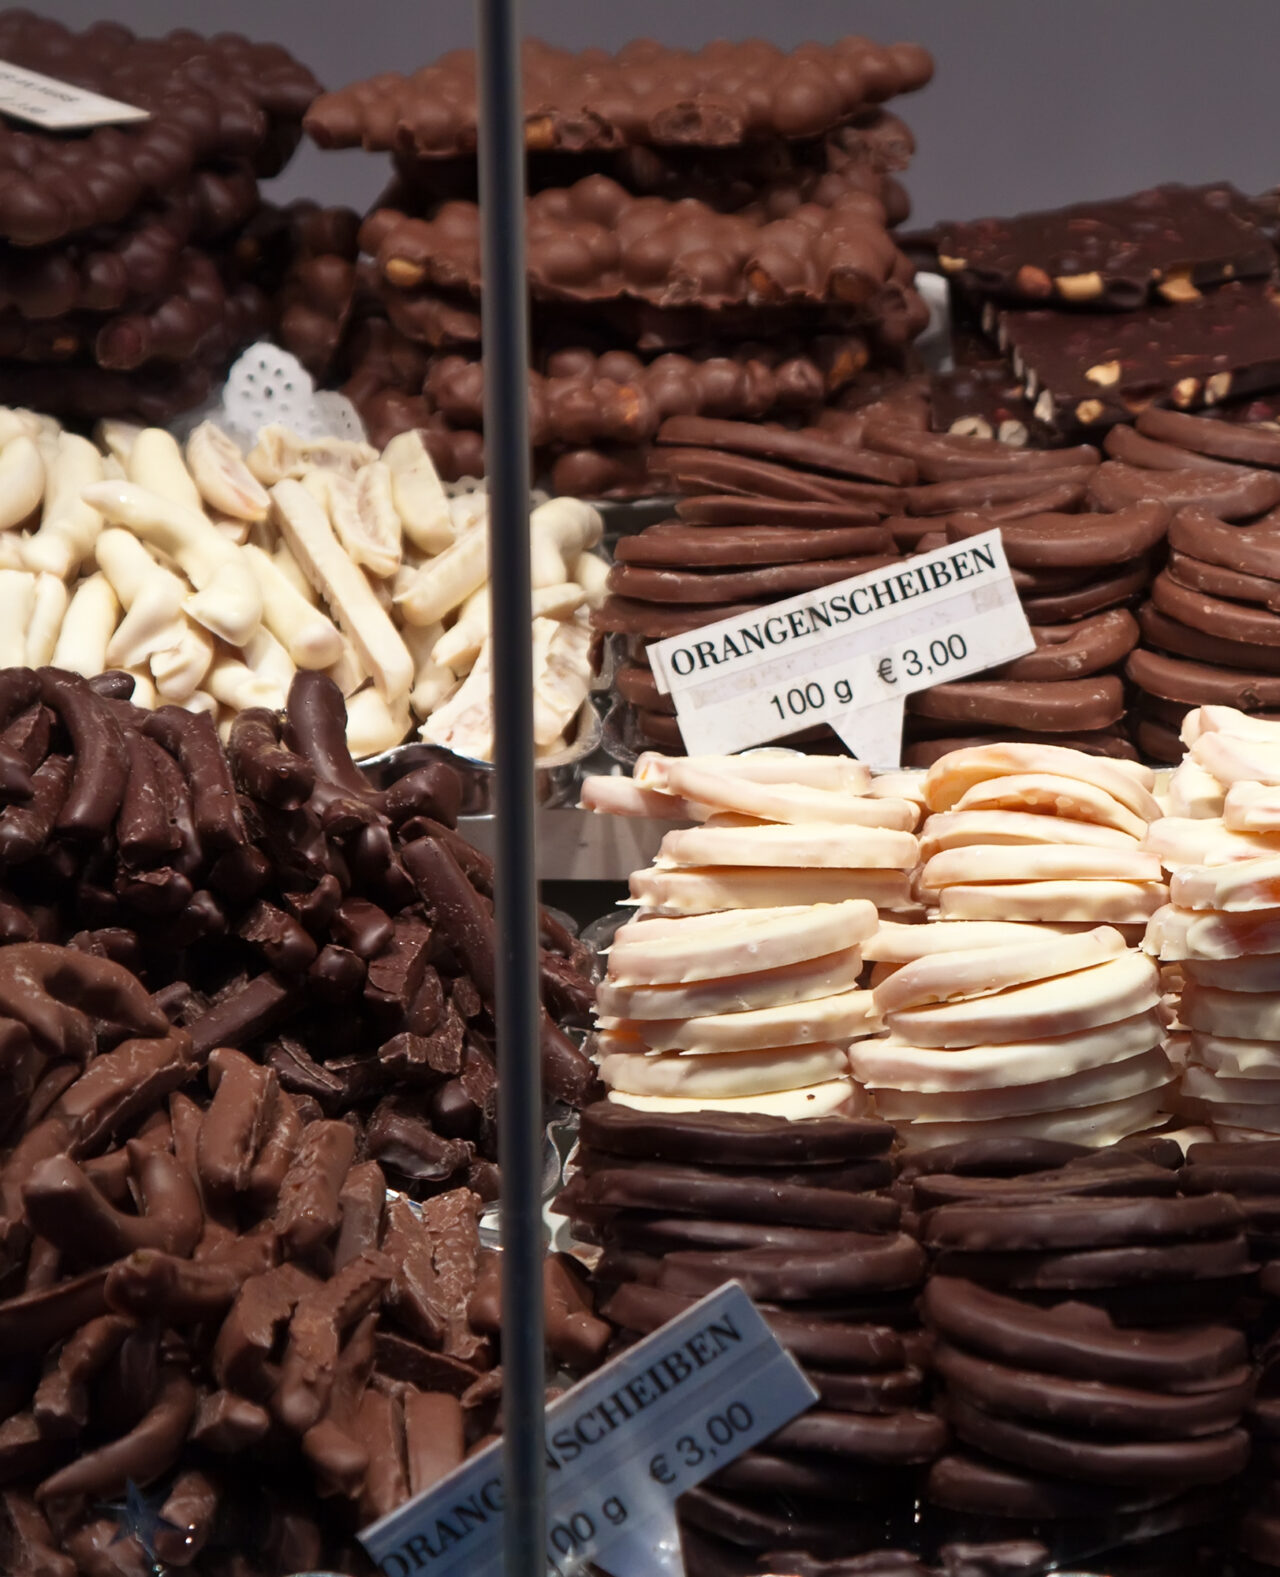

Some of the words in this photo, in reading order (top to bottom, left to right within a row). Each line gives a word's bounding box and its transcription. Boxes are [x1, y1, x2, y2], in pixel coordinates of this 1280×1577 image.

[670, 543, 997, 676] ORANGENSCHEIBEN
[770, 682, 826, 720] 100
[834, 679, 854, 704] g
[876, 657, 898, 684] €
[902, 633, 968, 675] 3,00
[602, 1495, 627, 1526] g
[649, 1453, 677, 1486] €
[676, 1401, 755, 1466] 3,00
